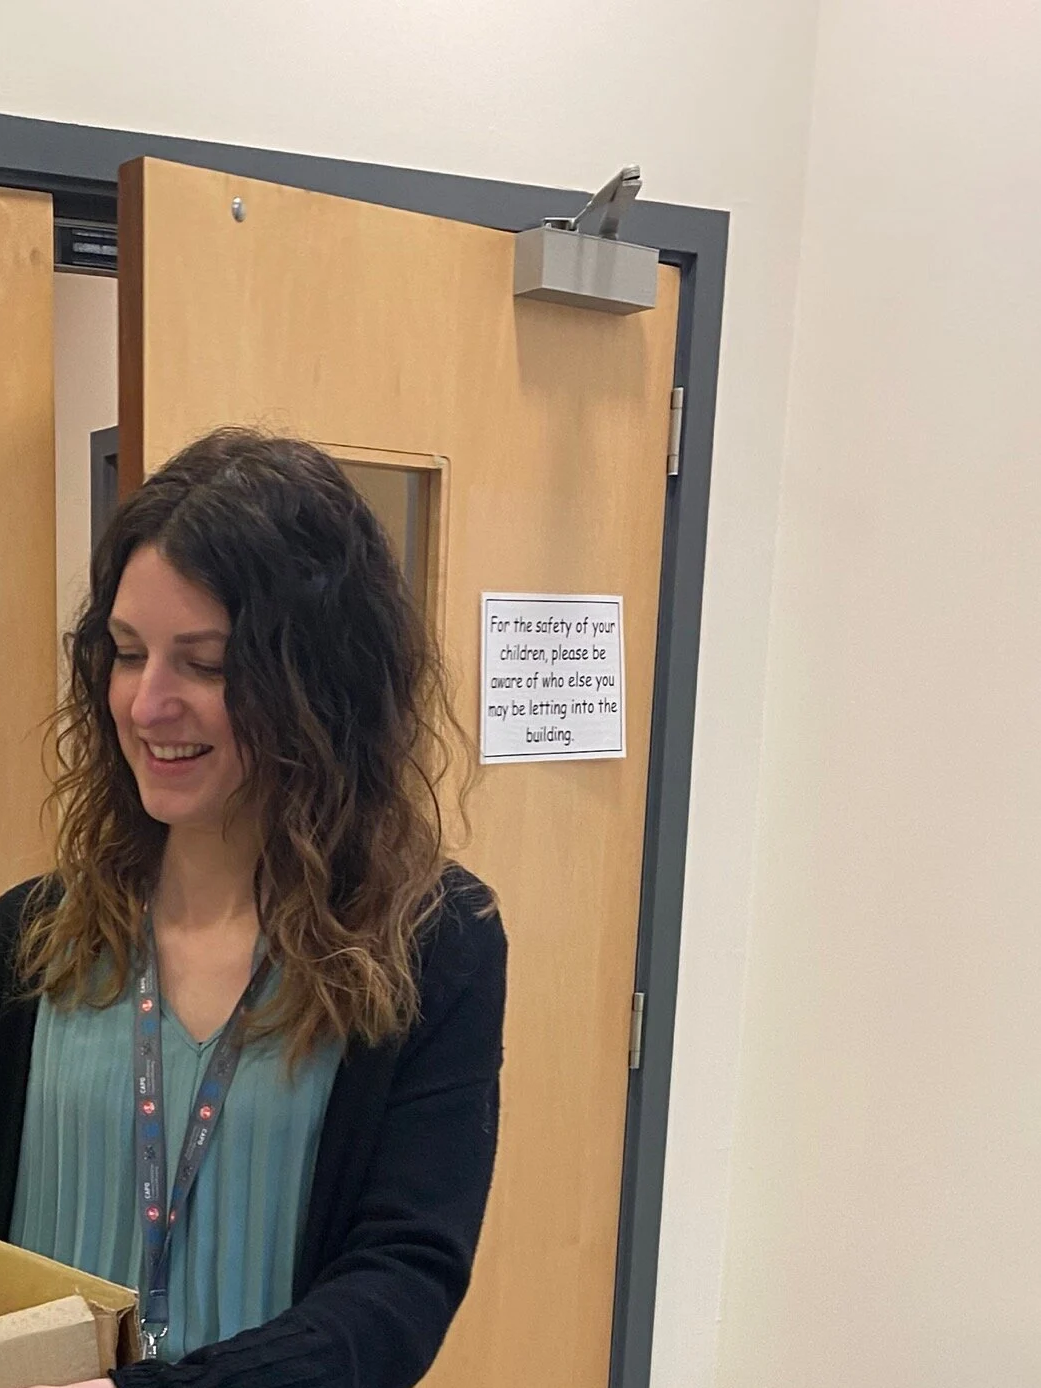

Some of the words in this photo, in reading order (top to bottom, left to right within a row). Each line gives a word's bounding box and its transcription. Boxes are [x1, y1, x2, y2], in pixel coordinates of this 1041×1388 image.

[490, 616, 510, 632] For
[514, 617, 532, 632] the
[536, 617, 572, 637] safety
[576, 617, 588, 633] of
[592, 622, 615, 637] your
[500, 645, 548, 663] children,
[551, 645, 588, 665] please
[593, 645, 606, 660] be
[491, 676, 523, 688] aware
[526, 672, 539, 688] of
[542, 672, 564, 687] who
[568, 672, 592, 687] else
[595, 675, 615, 692] you
[488, 706, 507, 721] may
[512, 701, 525, 716] be
[529, 700, 567, 719] letting
[571, 699, 594, 714] into
[598, 698, 617, 713] the
[526, 727, 575, 746] building.
